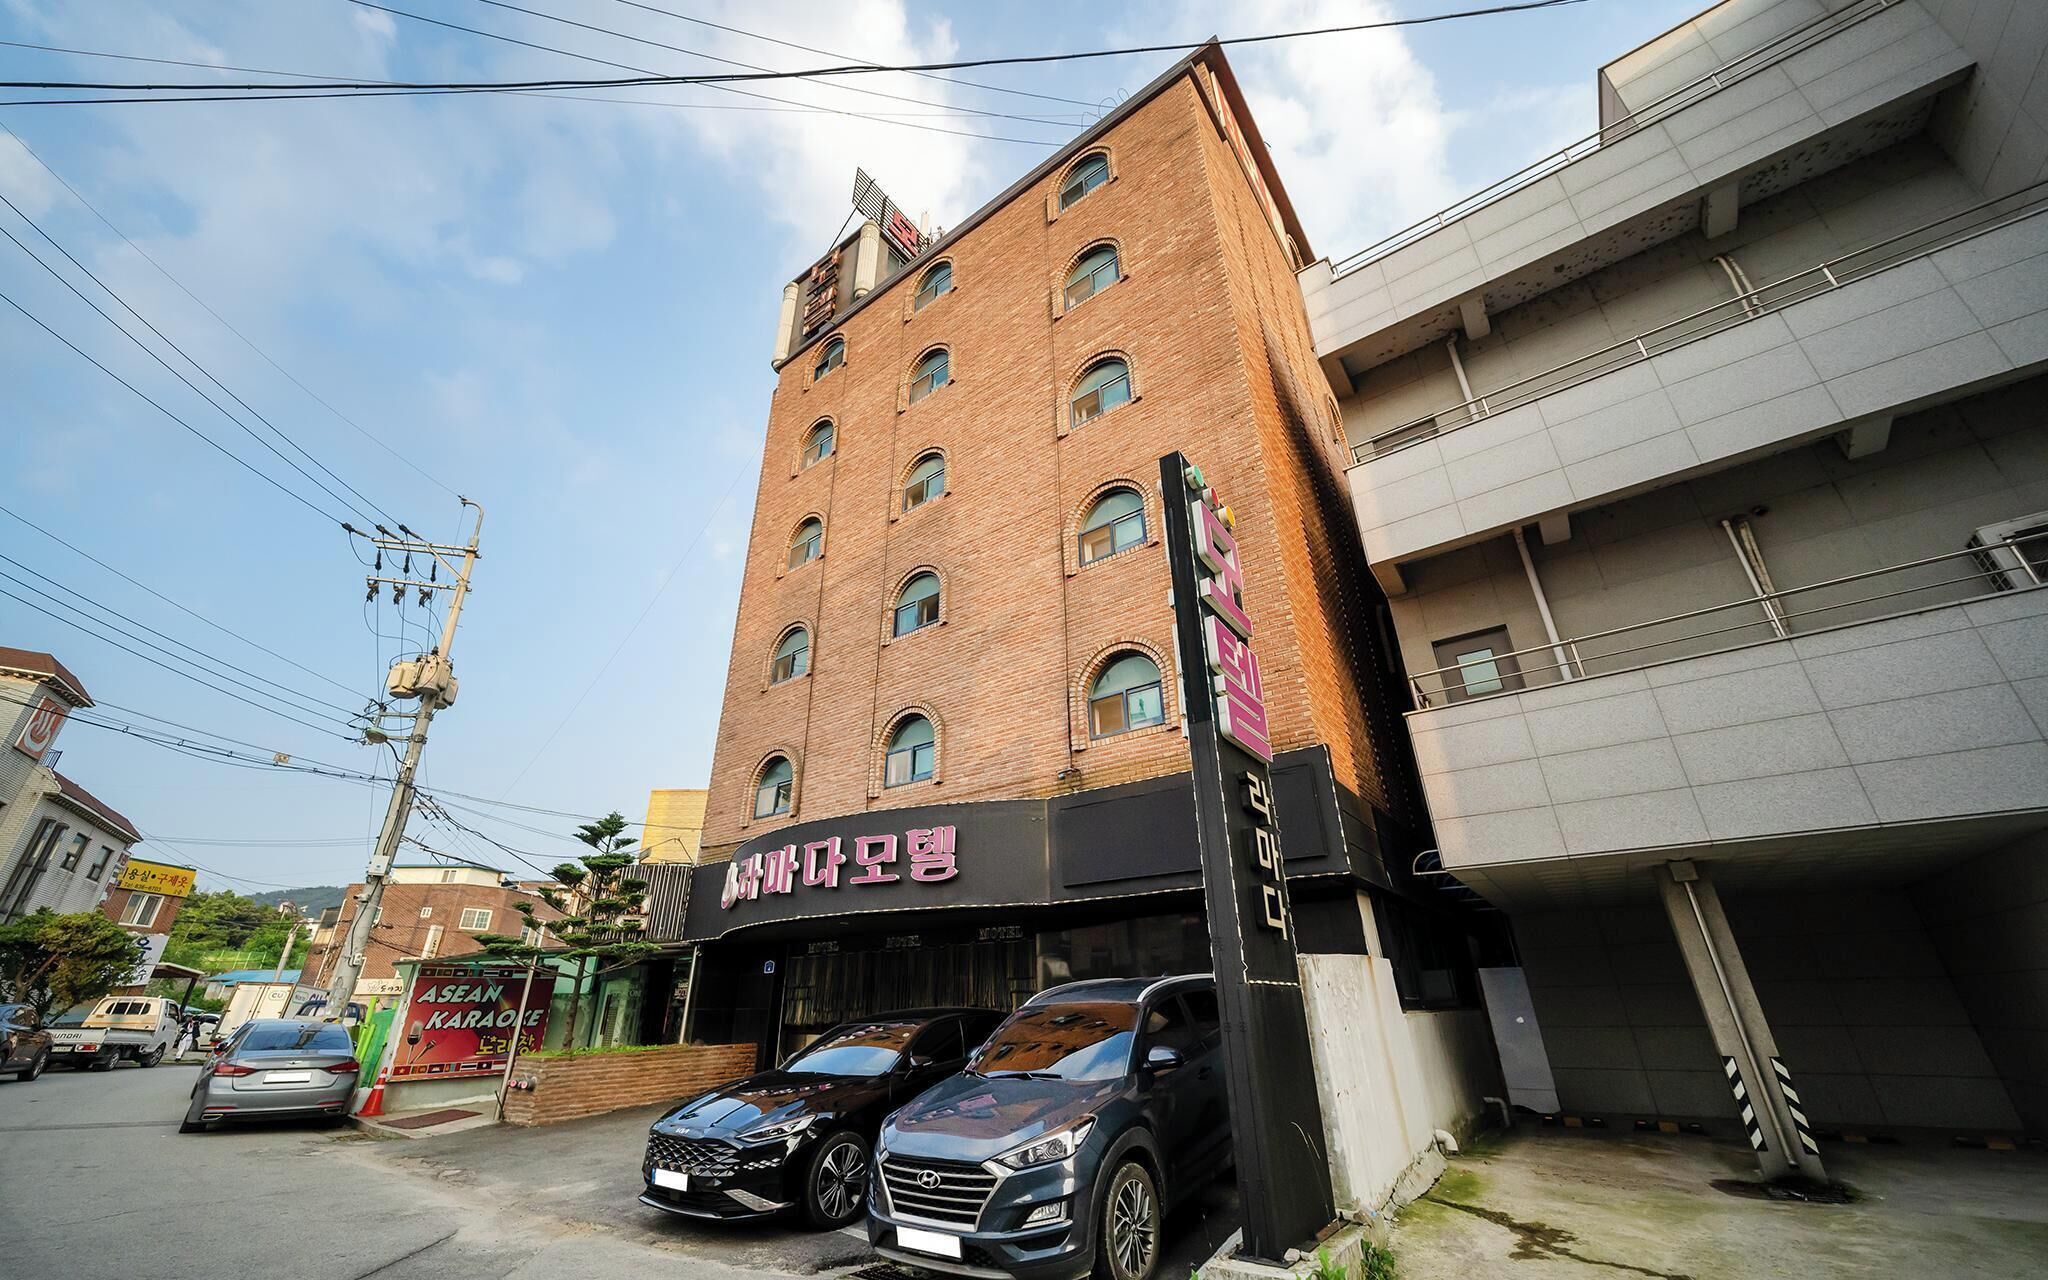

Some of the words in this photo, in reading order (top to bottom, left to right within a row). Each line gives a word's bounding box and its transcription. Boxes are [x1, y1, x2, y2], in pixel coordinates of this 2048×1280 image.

[1192, 499, 1273, 763] 모텔
[980, 925, 1024, 941] MOTEL
[416, 984, 505, 1004] ASEAN
[424, 1009, 545, 1031] KARAOKE
